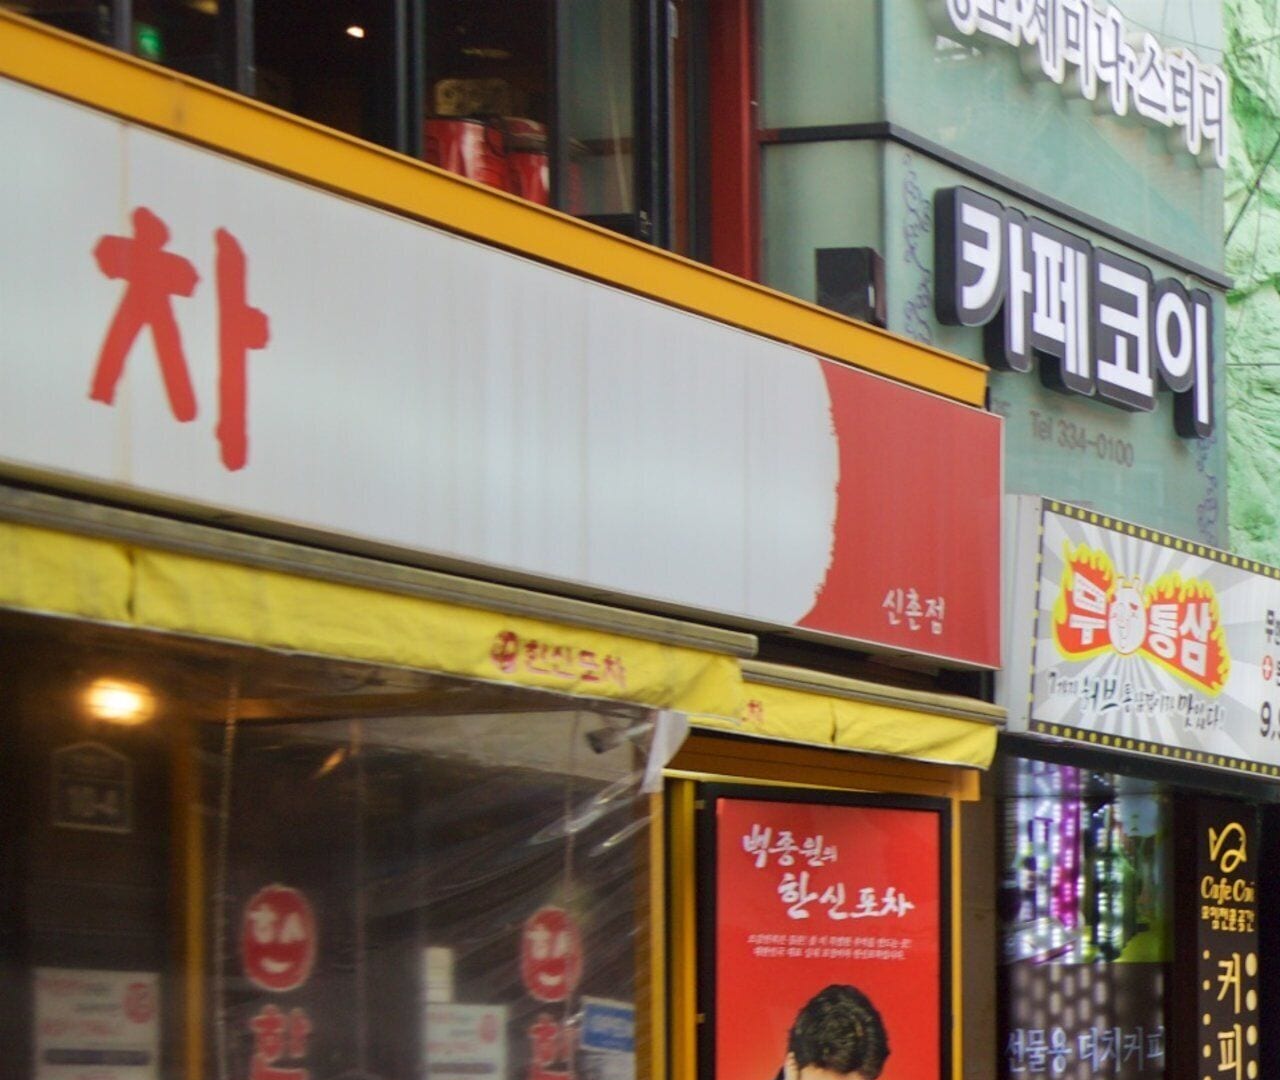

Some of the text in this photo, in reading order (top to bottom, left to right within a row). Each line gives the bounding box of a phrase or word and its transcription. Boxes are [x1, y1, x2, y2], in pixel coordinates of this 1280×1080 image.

[89, 205, 270, 472] 차
[961, 202, 1210, 425] 카페코이
[1030, 410, 1052, 437] Tel
[882, 588, 946, 635] 신촌점
[1147, 601, 1213, 677] 통삼
[1004, 1025, 1071, 1074] 선물용
